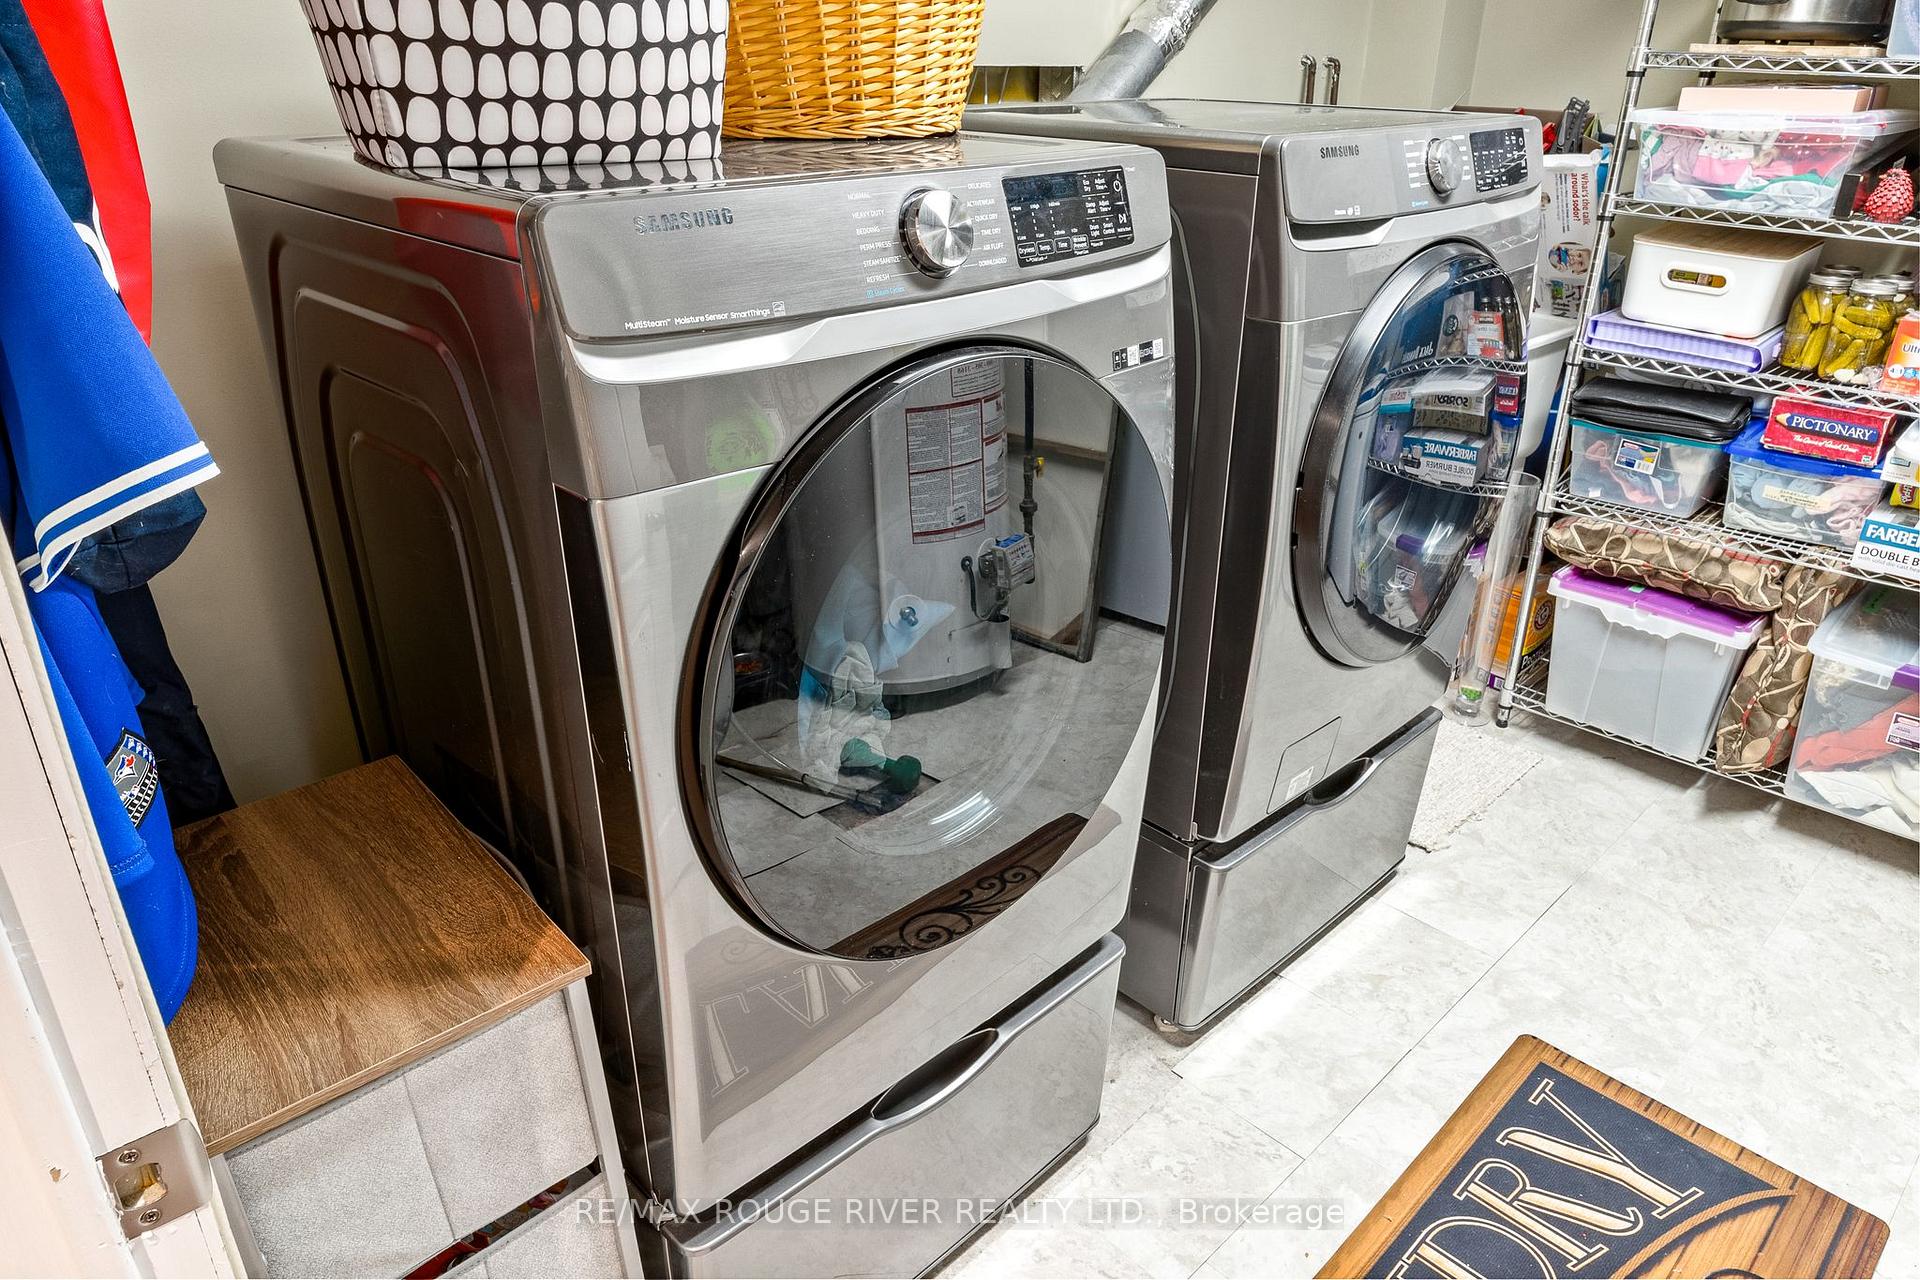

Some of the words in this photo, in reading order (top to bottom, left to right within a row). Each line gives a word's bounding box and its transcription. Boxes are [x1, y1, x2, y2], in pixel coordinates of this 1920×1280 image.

[1320, 144, 1359, 159] SAMSUNG
[1571, 173, 1580, 198] around
[1581, 173, 1590, 198] What's
[847, 192, 870, 200] NORMAL
[1582, 199, 1590, 211] the
[852, 211, 870, 219] HEAVY
[870, 209, 884, 217] DUTY
[1572, 199, 1581, 222] sodor?
[1582, 212, 1591, 226] talk
[633, 207, 734, 235] SAMSUNG
[860, 243, 874, 251] PERM
[874, 241, 892, 249] PRESS
[866, 274, 890, 283] REFRESH
[674, 315, 705, 326] Moisture
[705, 312, 730, 322] Sensor
[730, 308, 771, 319] SmartThings
[1792, 416, 1874, 441] PICTIONARY
[1865, 523, 1920, 548] FARBE
[1860, 545, 1910, 565] DOUBLE
